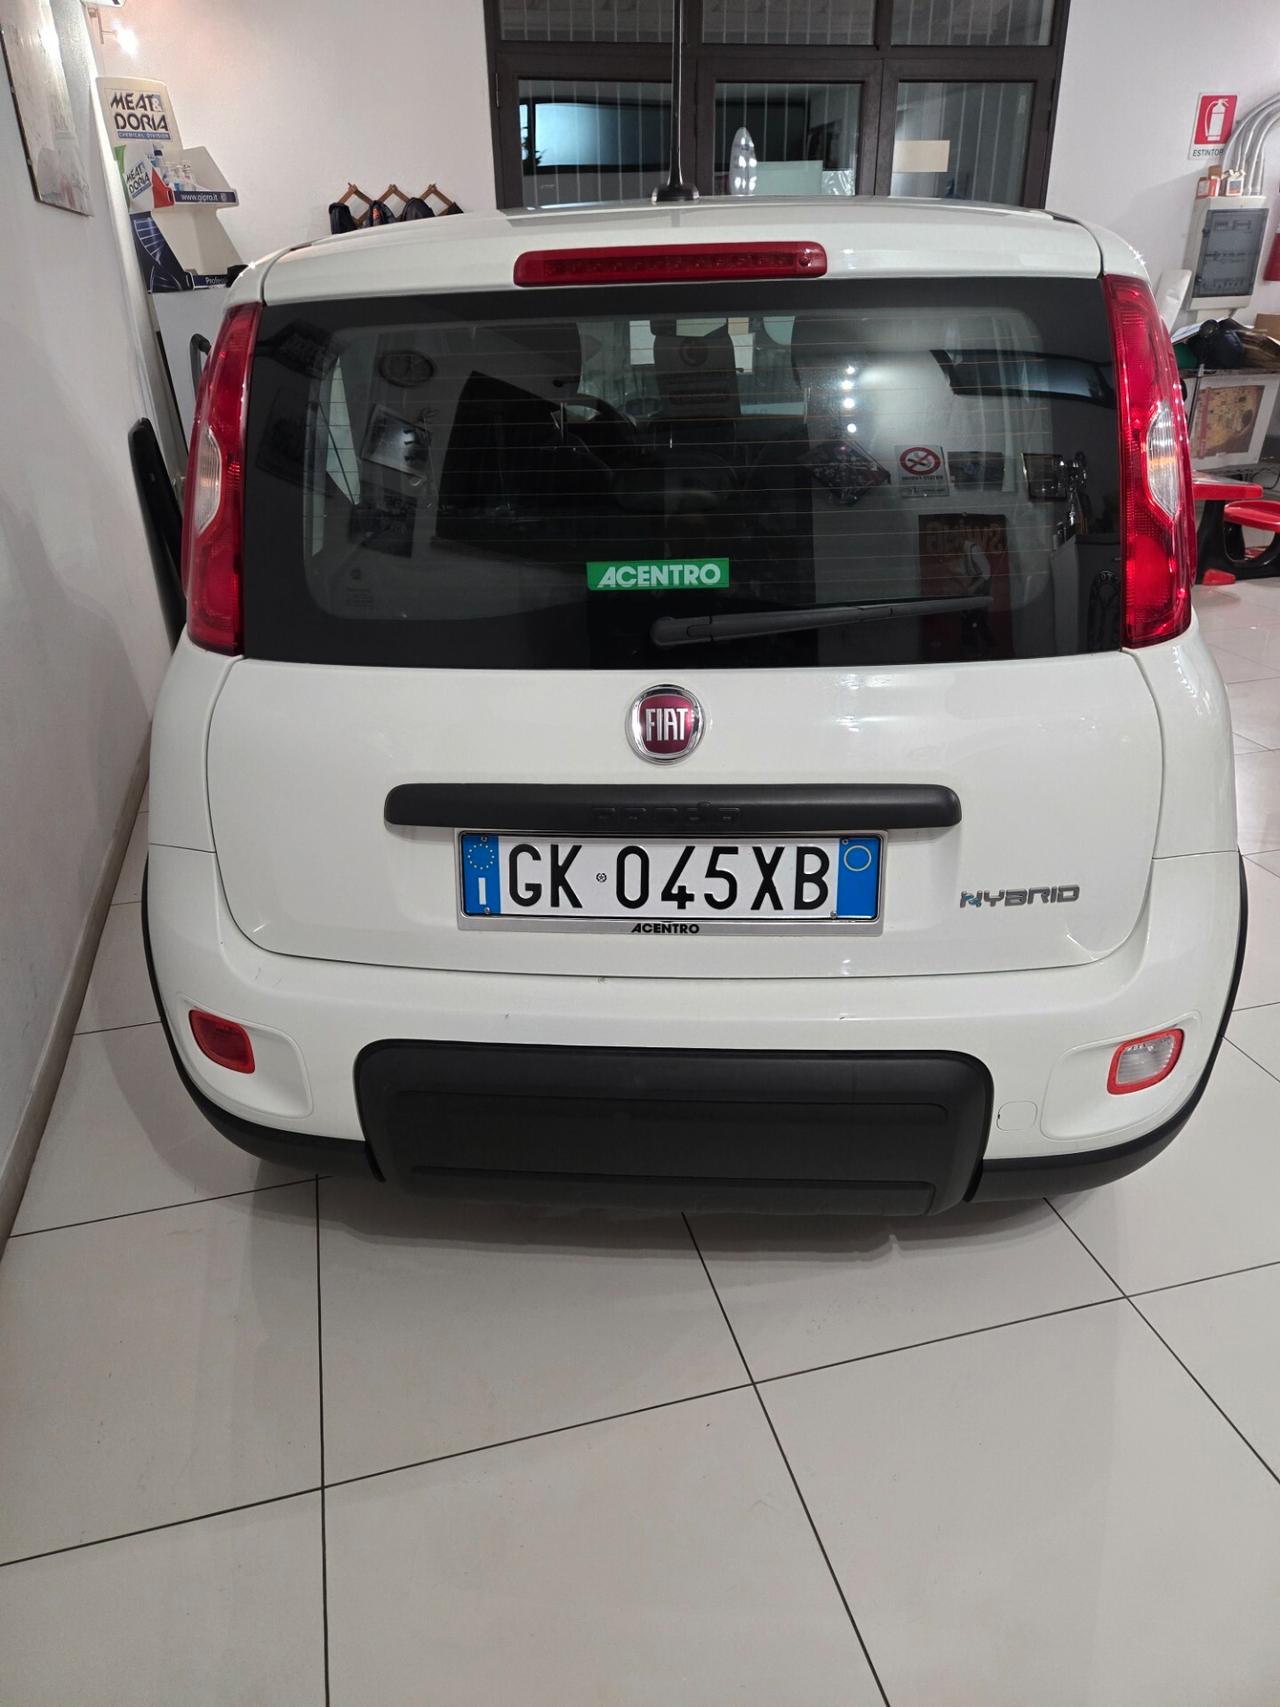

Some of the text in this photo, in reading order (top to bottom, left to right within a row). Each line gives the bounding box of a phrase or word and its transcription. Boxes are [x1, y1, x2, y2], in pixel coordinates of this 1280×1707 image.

[114, 112, 169, 131] DORIA
[1192, 148, 1225, 157] ESTINTOR
[597, 563, 721, 588] ACENTRO
[645, 708, 689, 742] FIAT
[509, 843, 830, 911] GK 045XB
[960, 884, 1080, 908] HYBRID
[631, 922, 700, 935] ACENTRO
